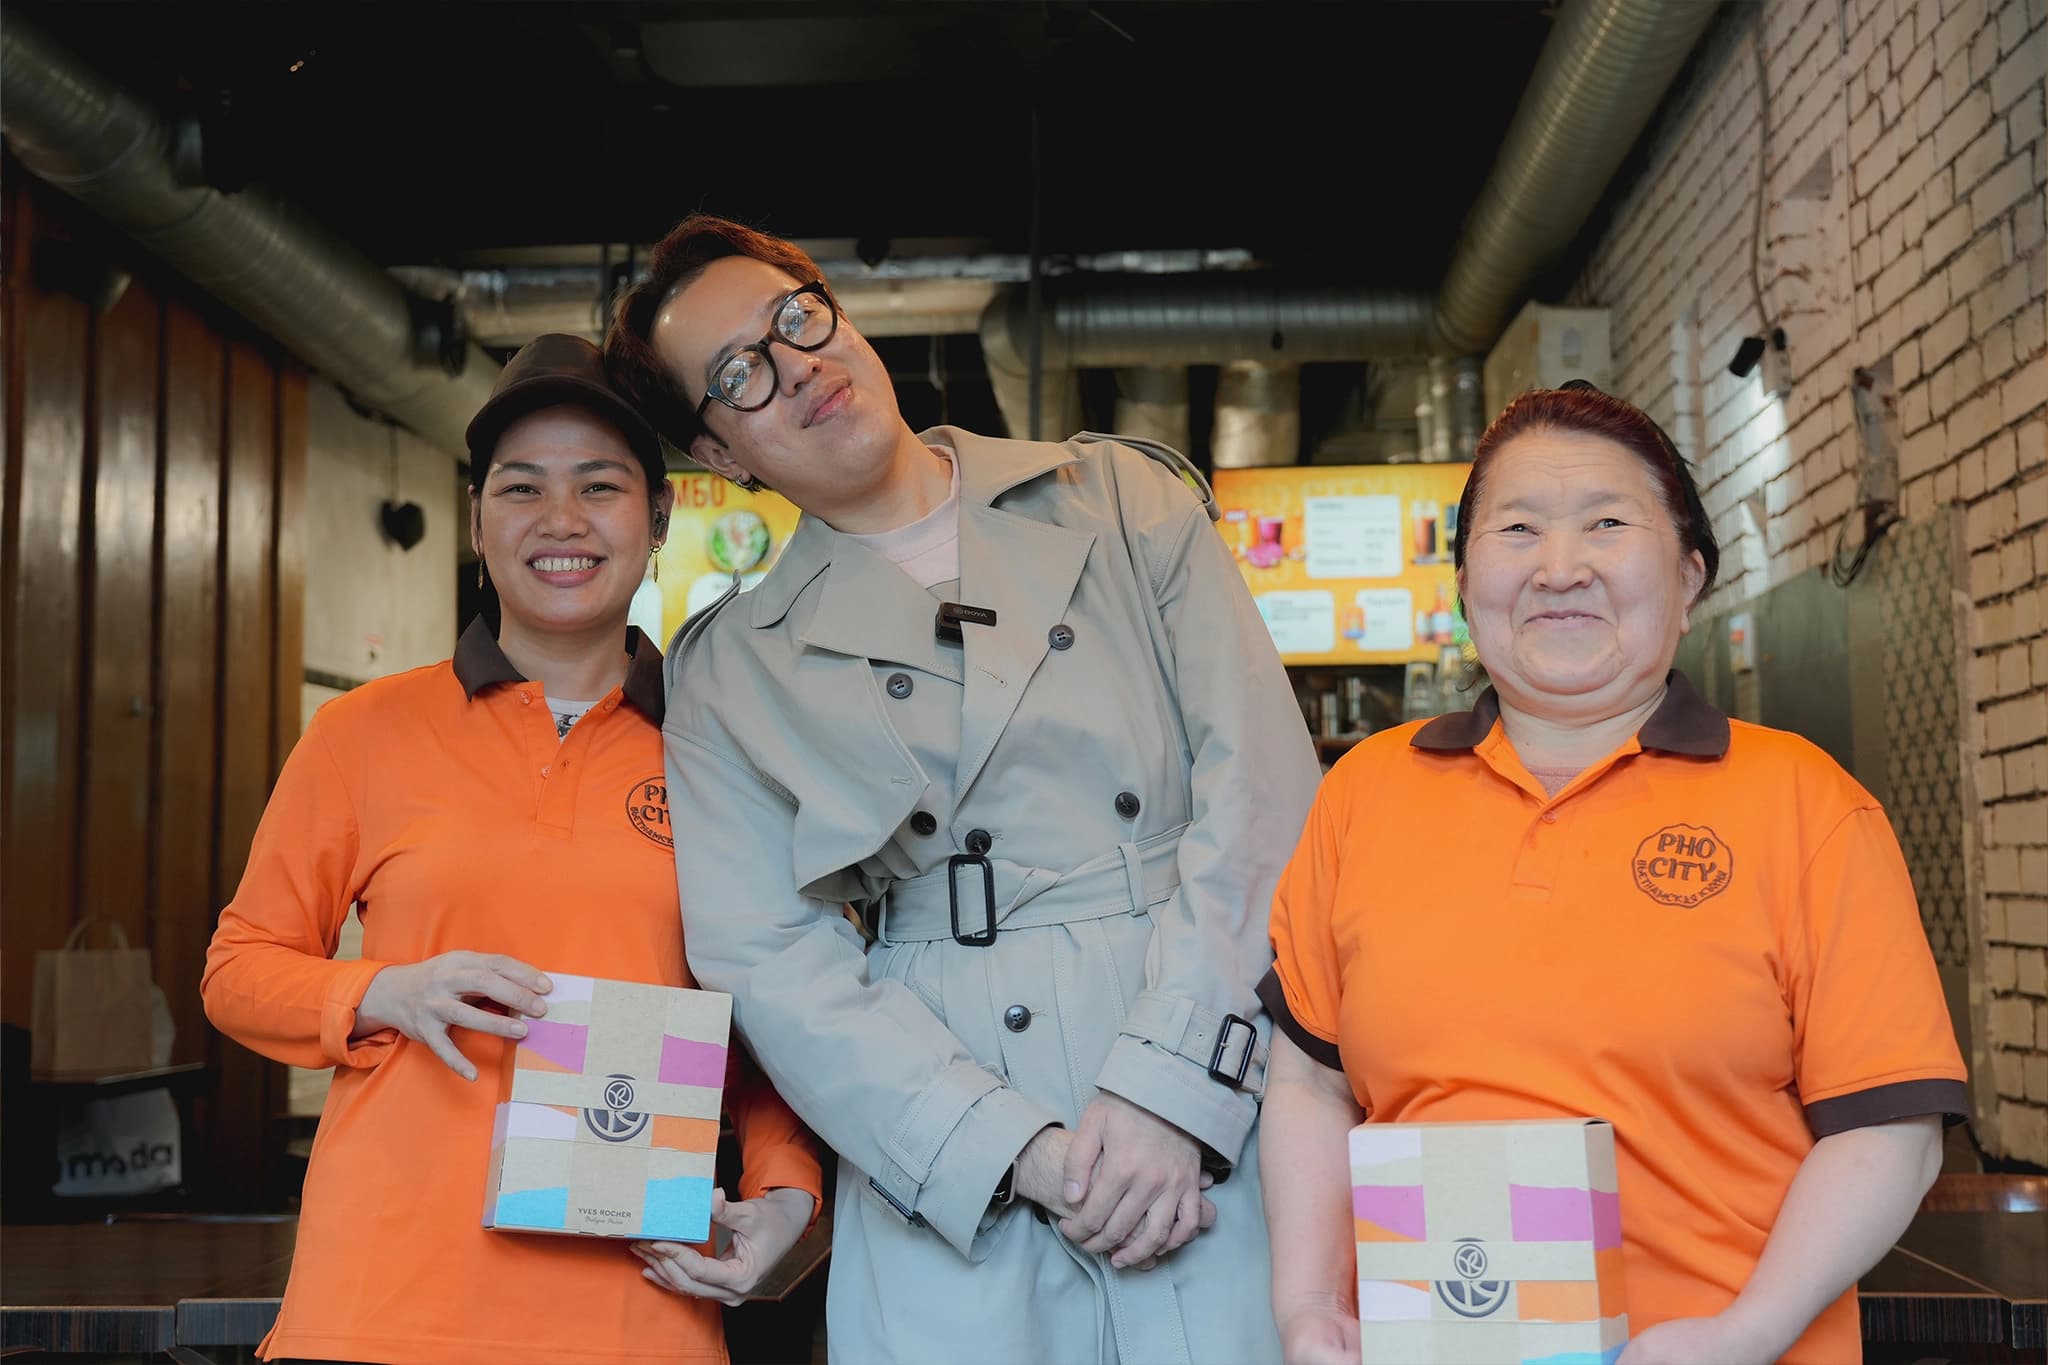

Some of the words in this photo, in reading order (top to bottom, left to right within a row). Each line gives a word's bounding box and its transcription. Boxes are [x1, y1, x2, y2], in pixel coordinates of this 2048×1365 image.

[1657, 832, 1717, 859] PHO
[1648, 857, 1717, 882] CITY
[577, 1207, 598, 1216] YVES
[599, 1208, 632, 1219] ROCHER
